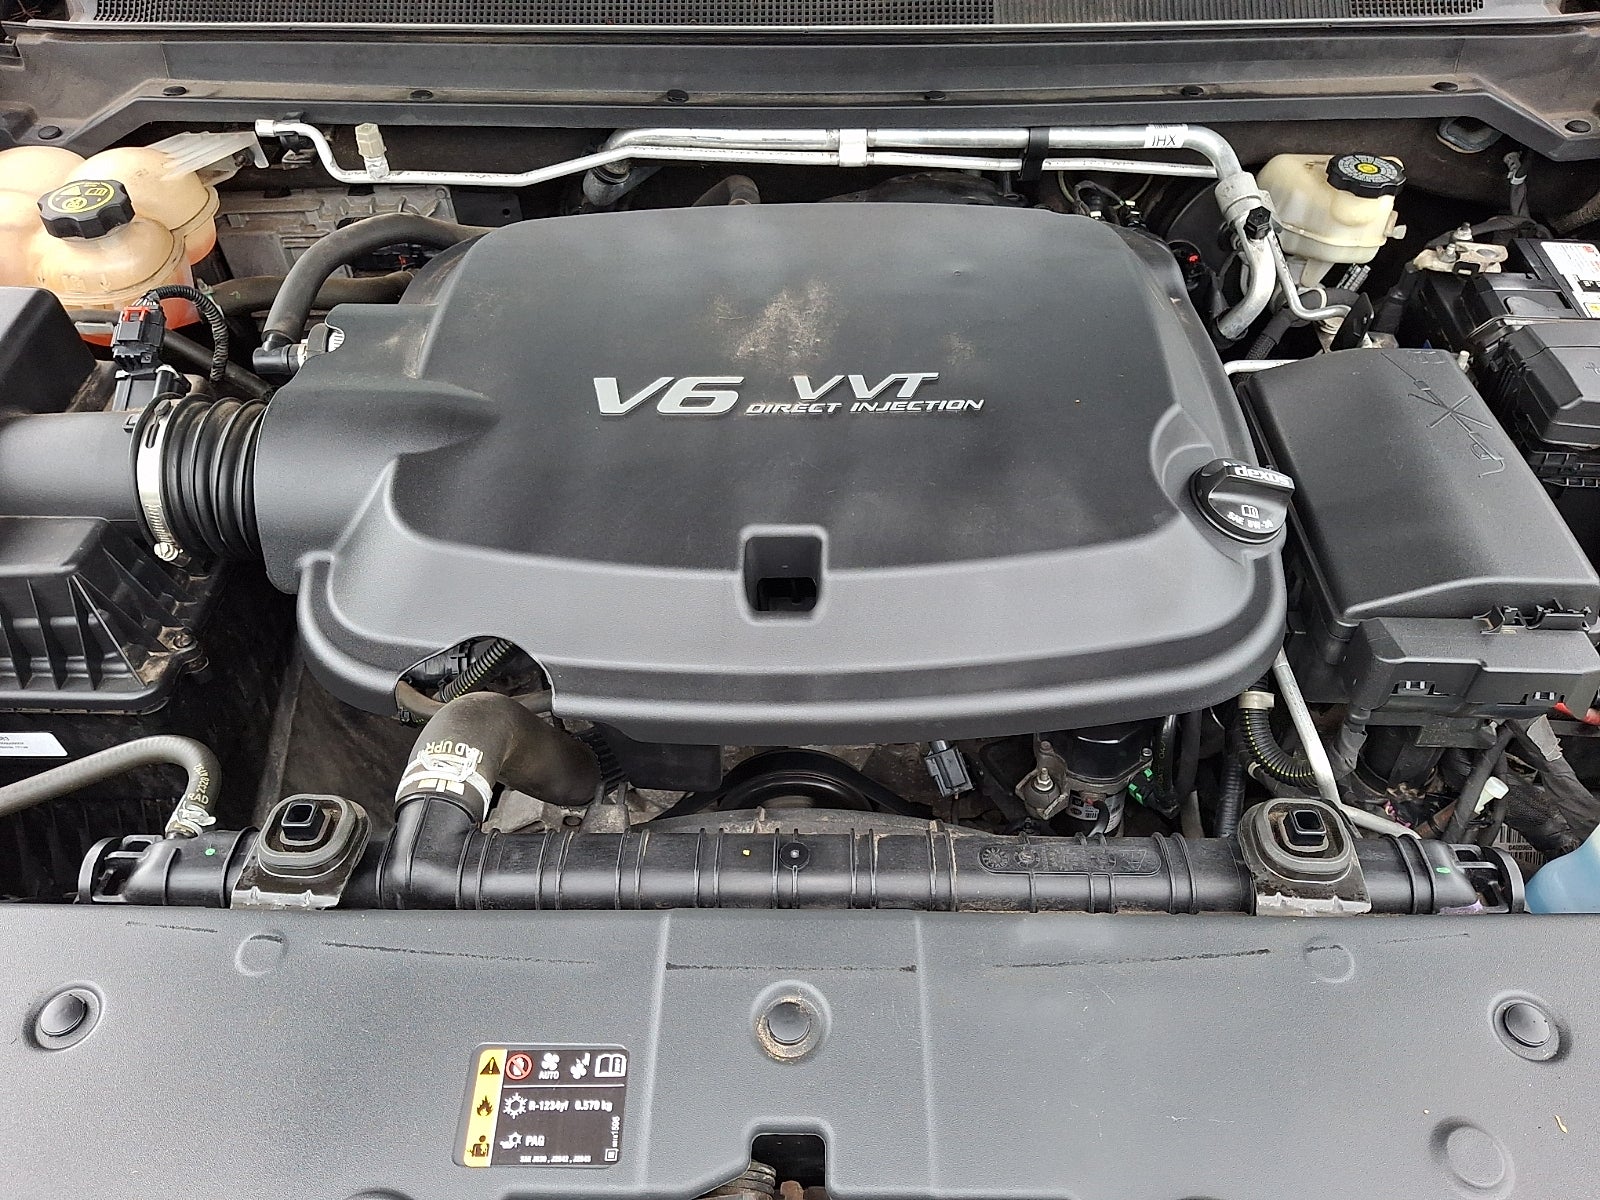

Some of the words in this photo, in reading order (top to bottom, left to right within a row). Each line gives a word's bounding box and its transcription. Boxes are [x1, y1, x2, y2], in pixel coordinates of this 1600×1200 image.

[593, 376, 744, 415] V6
[792, 372, 940, 400] VVT
[745, 401, 842, 415] DIRECT
[849, 399, 985, 414] INJECTION
[1234, 465, 1290, 487] dexos
[425, 740, 453, 755] UPR
[187, 793, 209, 804] RAD
[538, 1071, 560, 1080] AUTO
[525, 1135, 545, 1147] PAG
